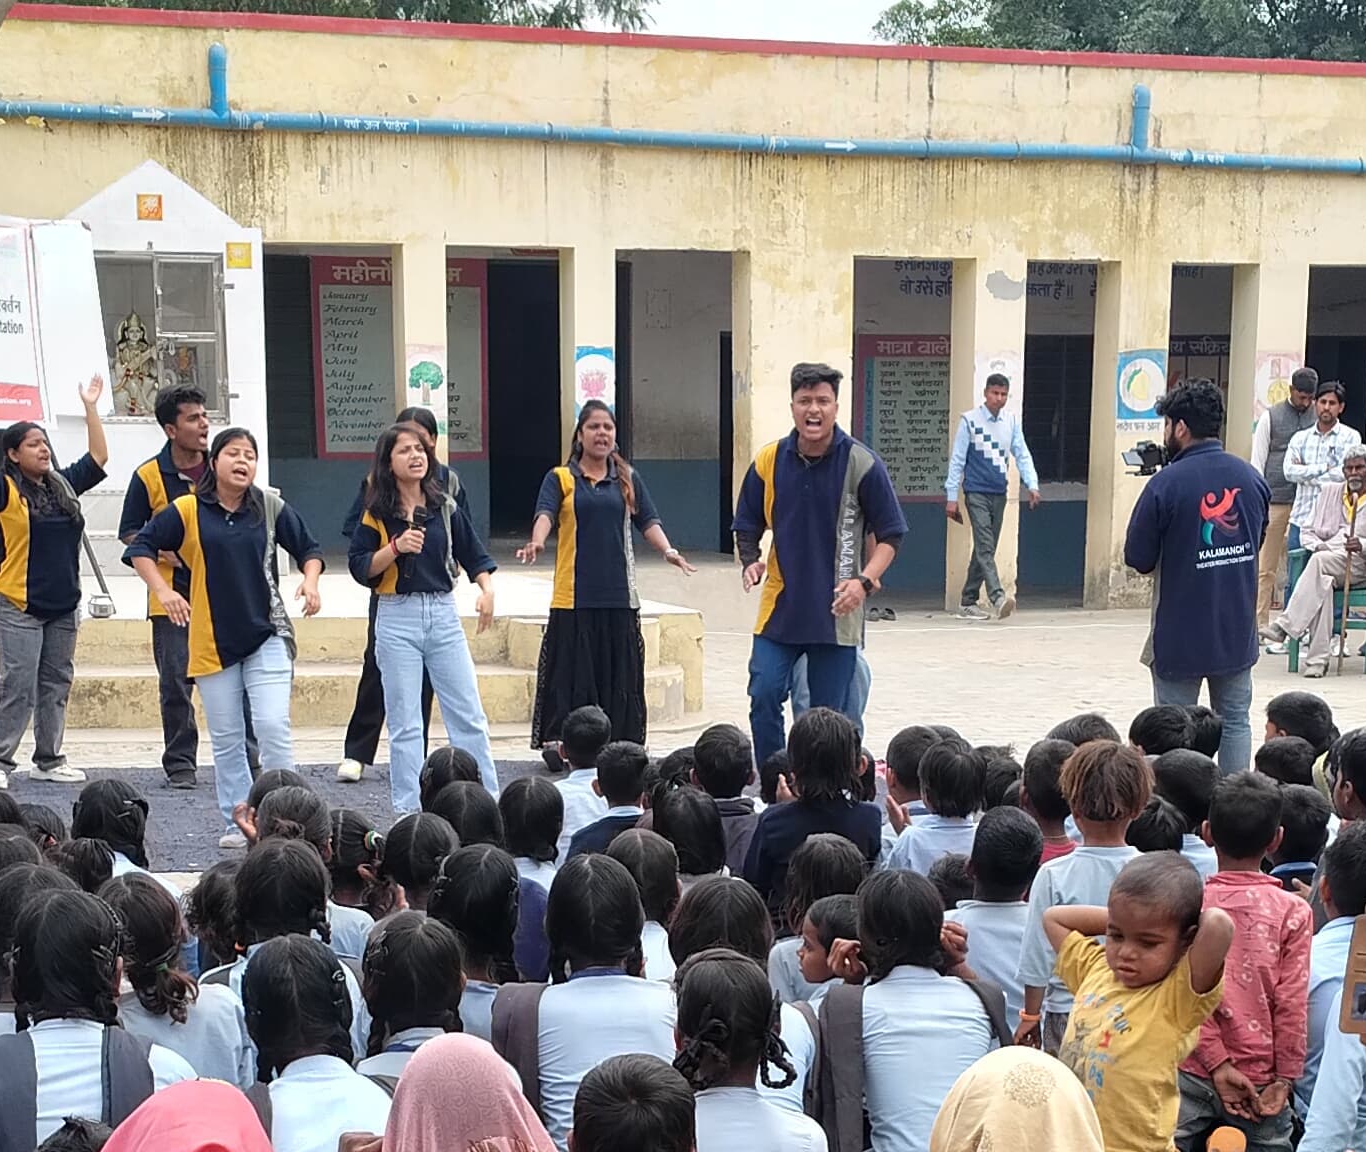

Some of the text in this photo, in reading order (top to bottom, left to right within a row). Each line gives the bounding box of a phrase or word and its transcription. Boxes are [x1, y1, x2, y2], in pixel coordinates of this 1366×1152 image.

[322, 291, 370, 302] January
[323, 303, 378, 316] February
[323, 318, 364, 327] March
[324, 330, 359, 342] April
[324, 343, 359, 355] May
[876, 340, 914, 354] मात्रा
[325, 357, 358, 366] June
[325, 369, 356, 381] July
[326, 382, 373, 393] August
[326, 394, 387, 407] September
[327, 407, 373, 418] October
[327, 420, 385, 430] November
[330, 433, 381, 443] Decembe
[1198, 544, 1245, 560] KALAMANCH
